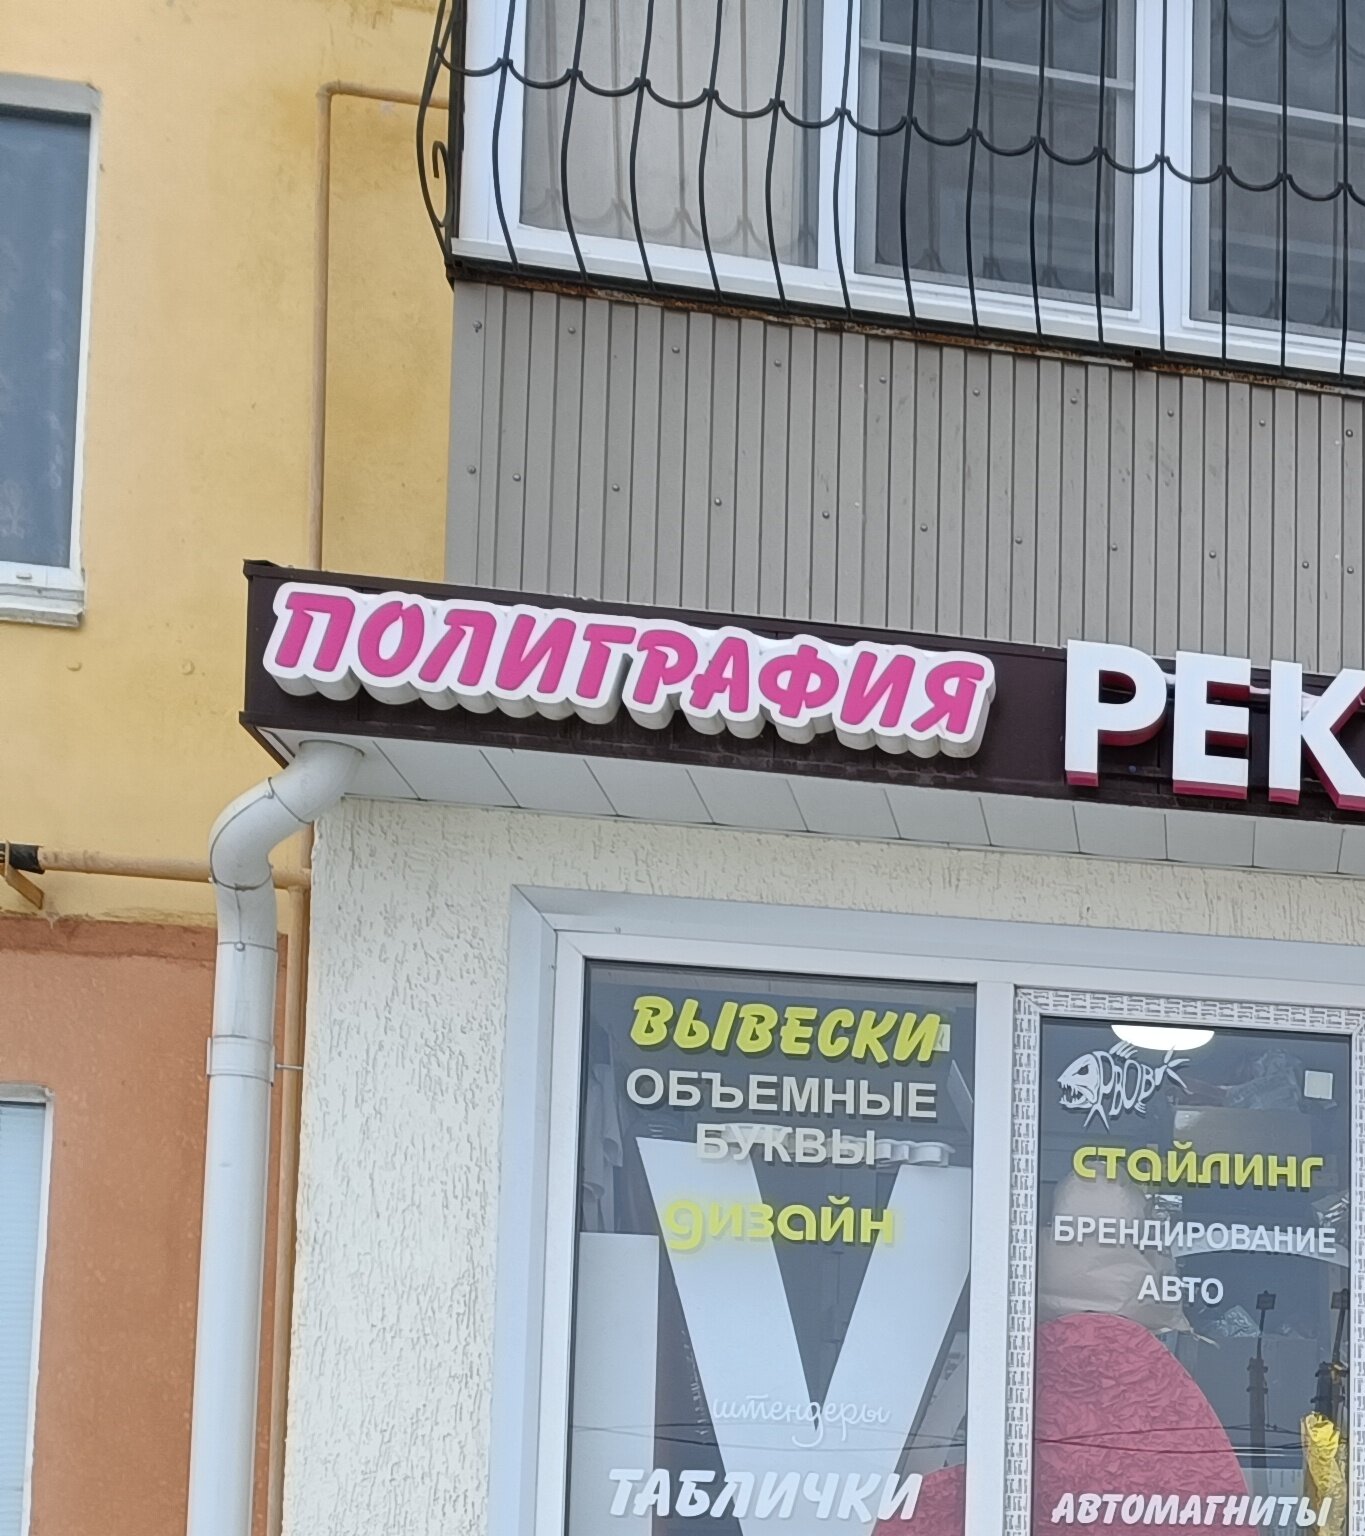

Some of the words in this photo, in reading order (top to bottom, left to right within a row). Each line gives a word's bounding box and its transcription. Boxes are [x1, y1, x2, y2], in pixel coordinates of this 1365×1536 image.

[265, 583, 994, 755] ПОЛИГРАФИЯ
[629, 995, 941, 1063] ВЫВЕСКИ
[626, 1067, 938, 1121] ОБЪЕМНЫЕ
[696, 1124, 877, 1168] БУКВЫ
[662, 1195, 897, 1252] дизайн
[1053, 1214, 1338, 1256] БРЕНДИРОВАНИЕ
[1137, 1275, 1225, 1307] АВТО
[711, 1393, 891, 1446] штендеры
[608, 1469, 923, 1523] ТАБЛИЧКИ
[1051, 1492, 1333, 1528] АВТОМАГНИТЫ
